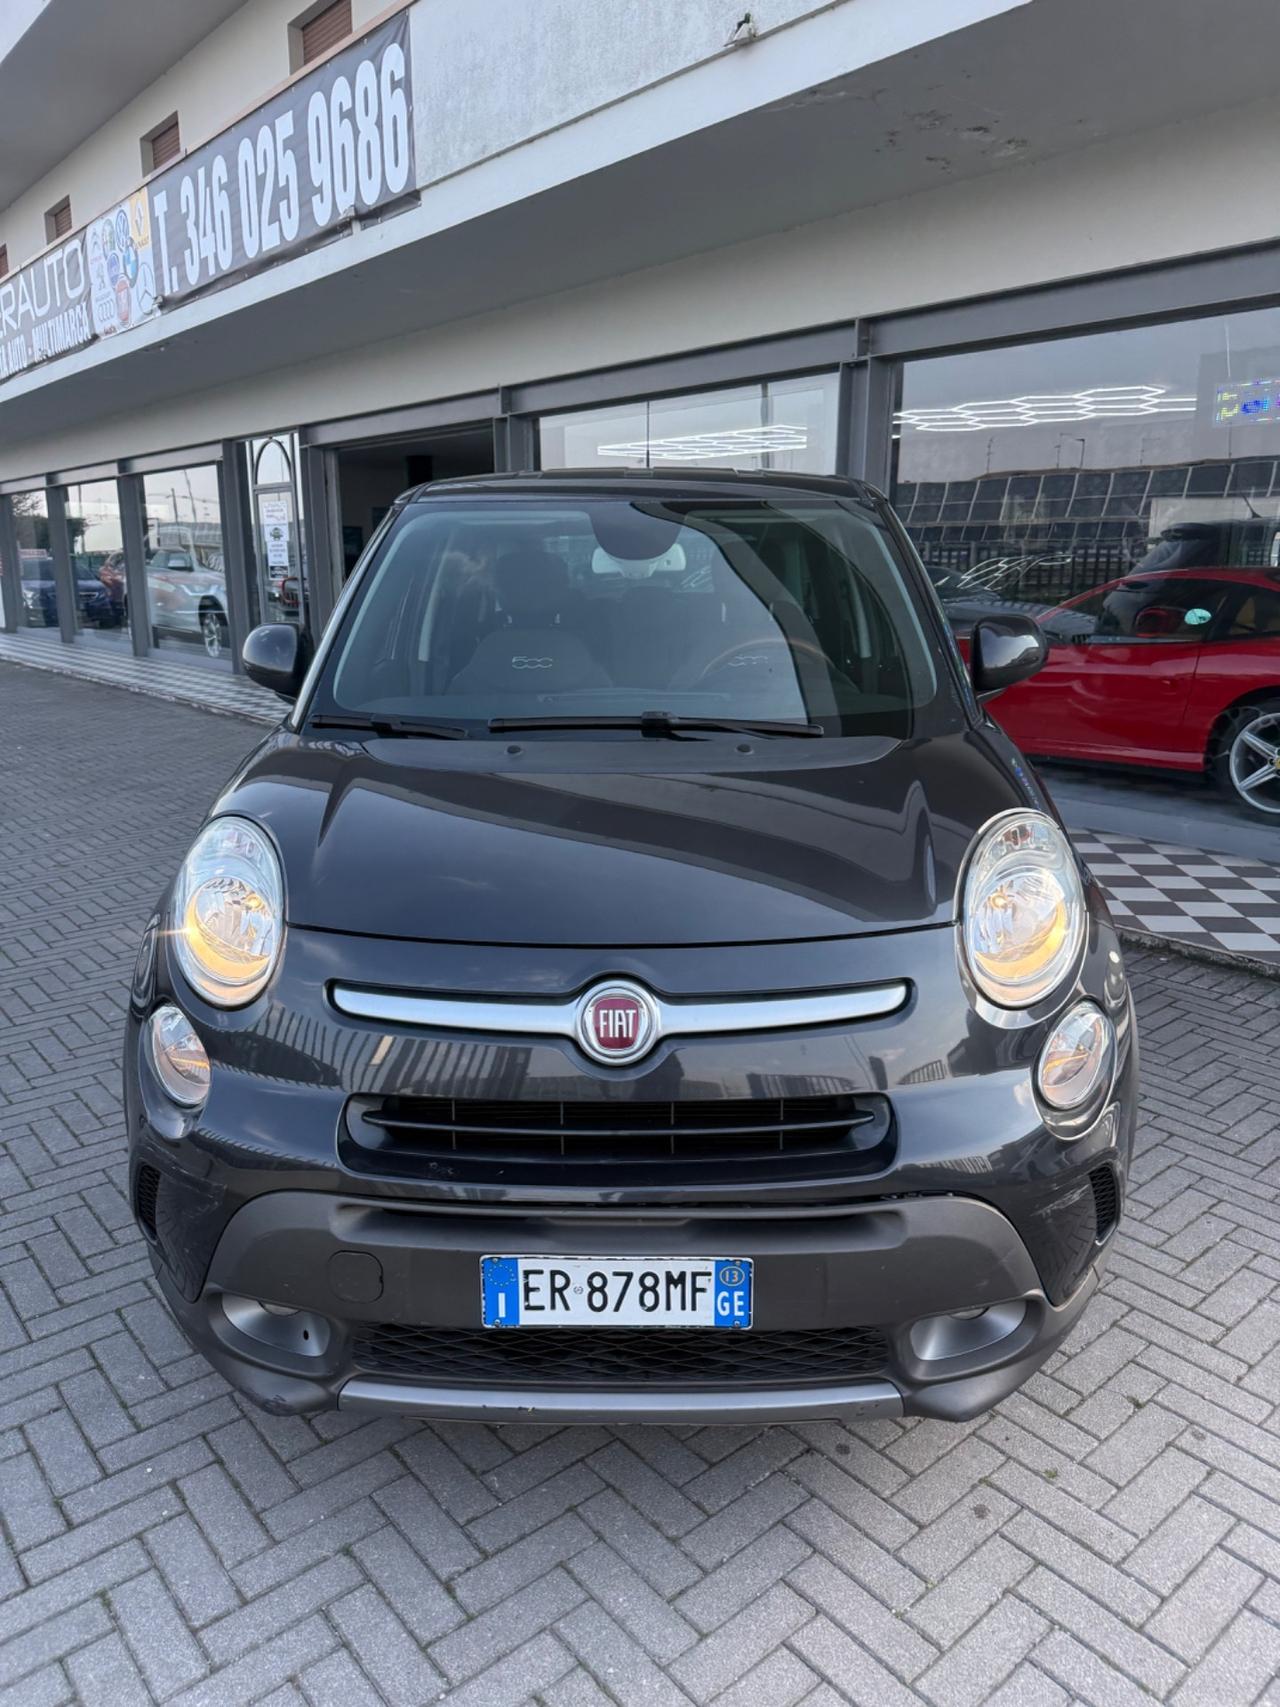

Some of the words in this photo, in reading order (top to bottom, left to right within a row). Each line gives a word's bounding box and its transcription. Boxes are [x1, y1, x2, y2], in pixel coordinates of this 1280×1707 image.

[154, 190, 180, 296] T.
[180, 155, 233, 286] 346
[238, 111, 299, 258] 025
[307, 43, 410, 227] 9686
[0, 239, 85, 337] RAUTO
[512, 656, 552, 669] 500
[599, 1009, 637, 1038] FIAT
[498, 1292, 506, 1318] I
[522, 1269, 571, 1311] ER
[587, 1270, 712, 1312] 878MF
[717, 1291, 745, 1317] GE
[725, 1270, 739, 1283] 13
